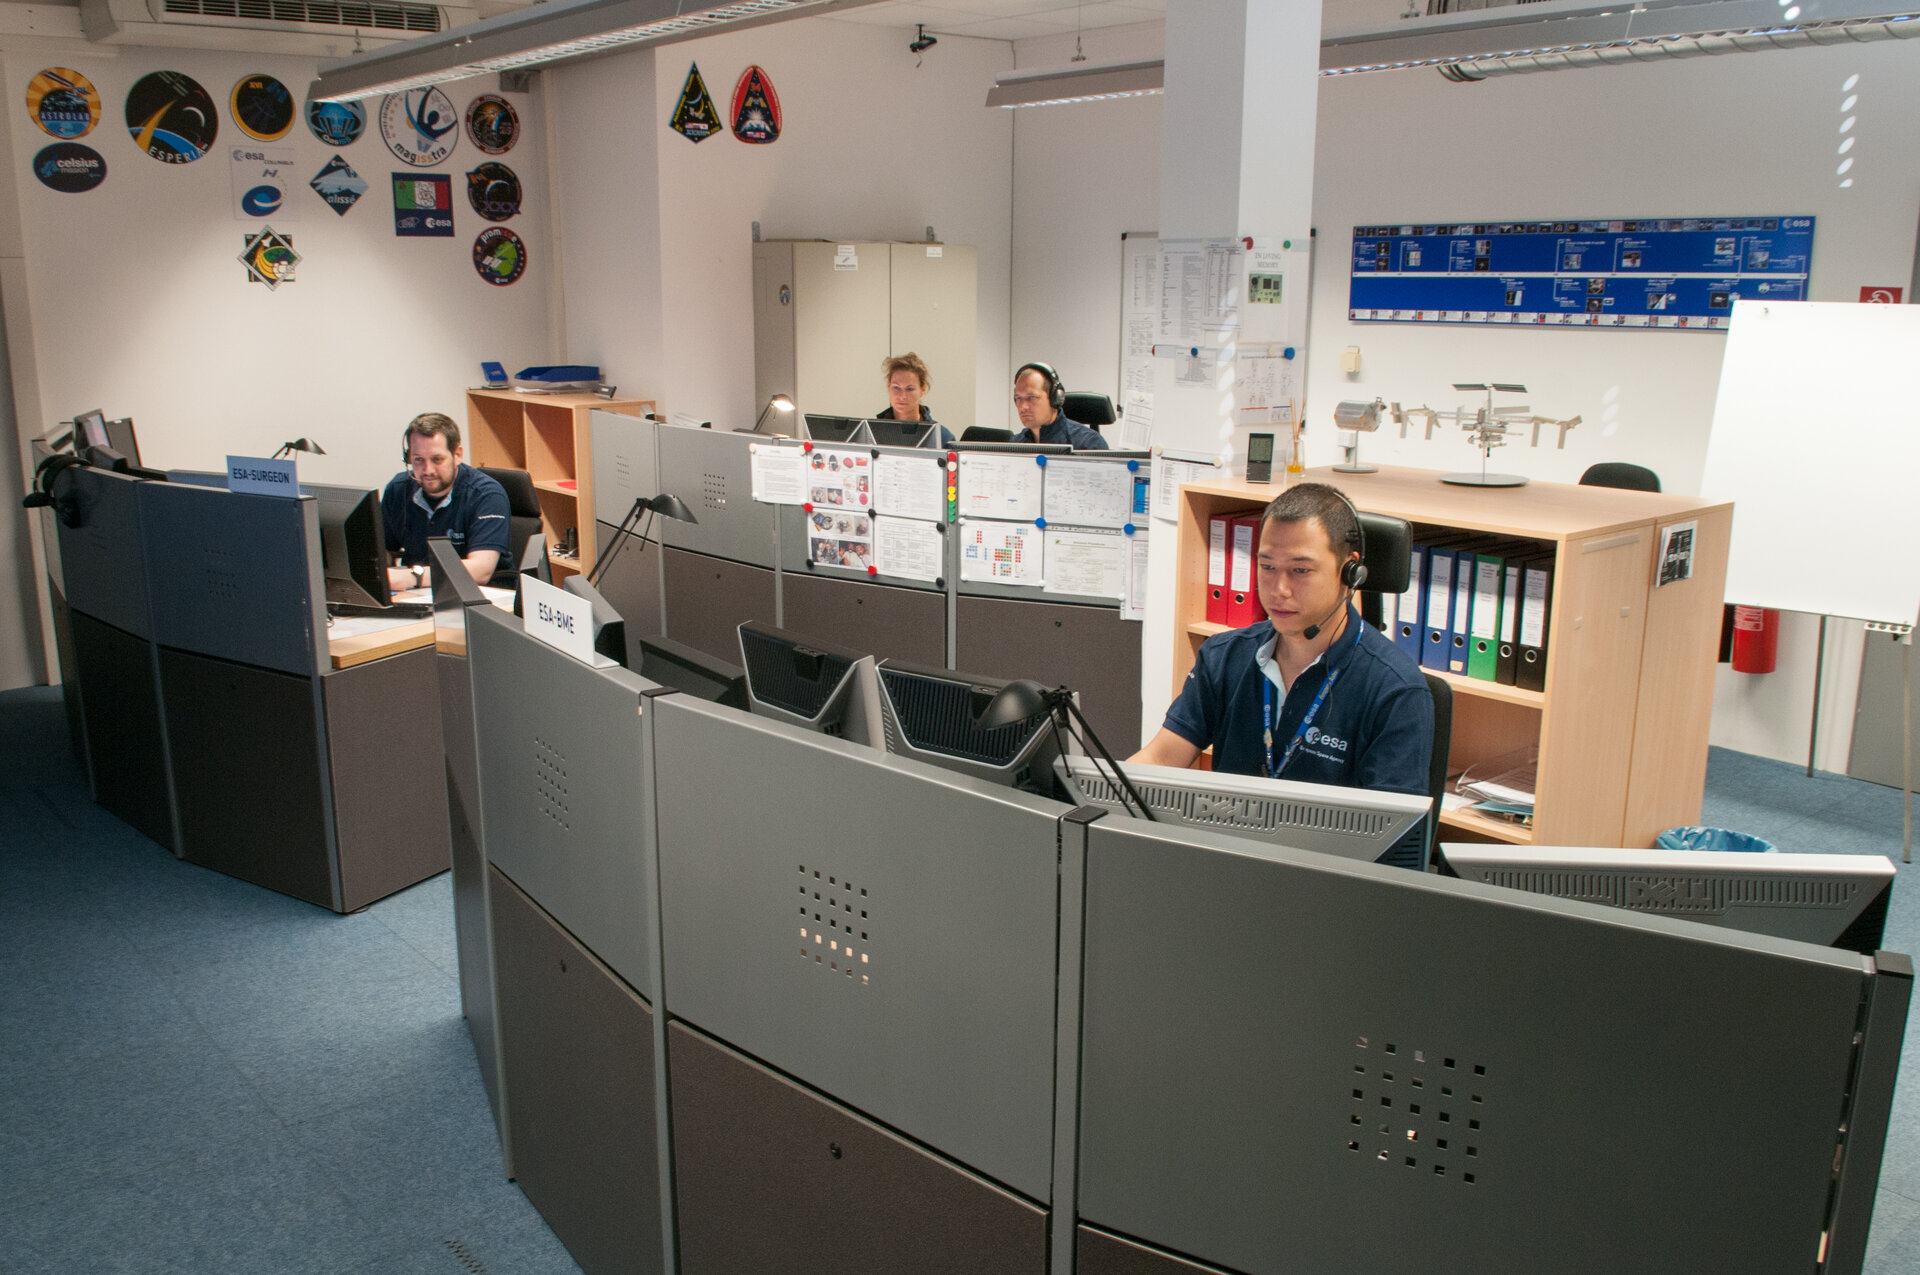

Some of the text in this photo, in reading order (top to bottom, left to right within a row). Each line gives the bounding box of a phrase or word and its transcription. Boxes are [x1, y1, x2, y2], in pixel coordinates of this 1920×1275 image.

[41, 112, 90, 121] ASTROLAB
[245, 152, 264, 160] esa
[394, 143, 447, 163] magisstra
[57, 157, 99, 168] celsius
[436, 219, 452, 227] esa
[233, 468, 290, 484] ESA-SURGEON
[539, 602, 575, 635] ESA-BME
[1321, 734, 1347, 751] esa
